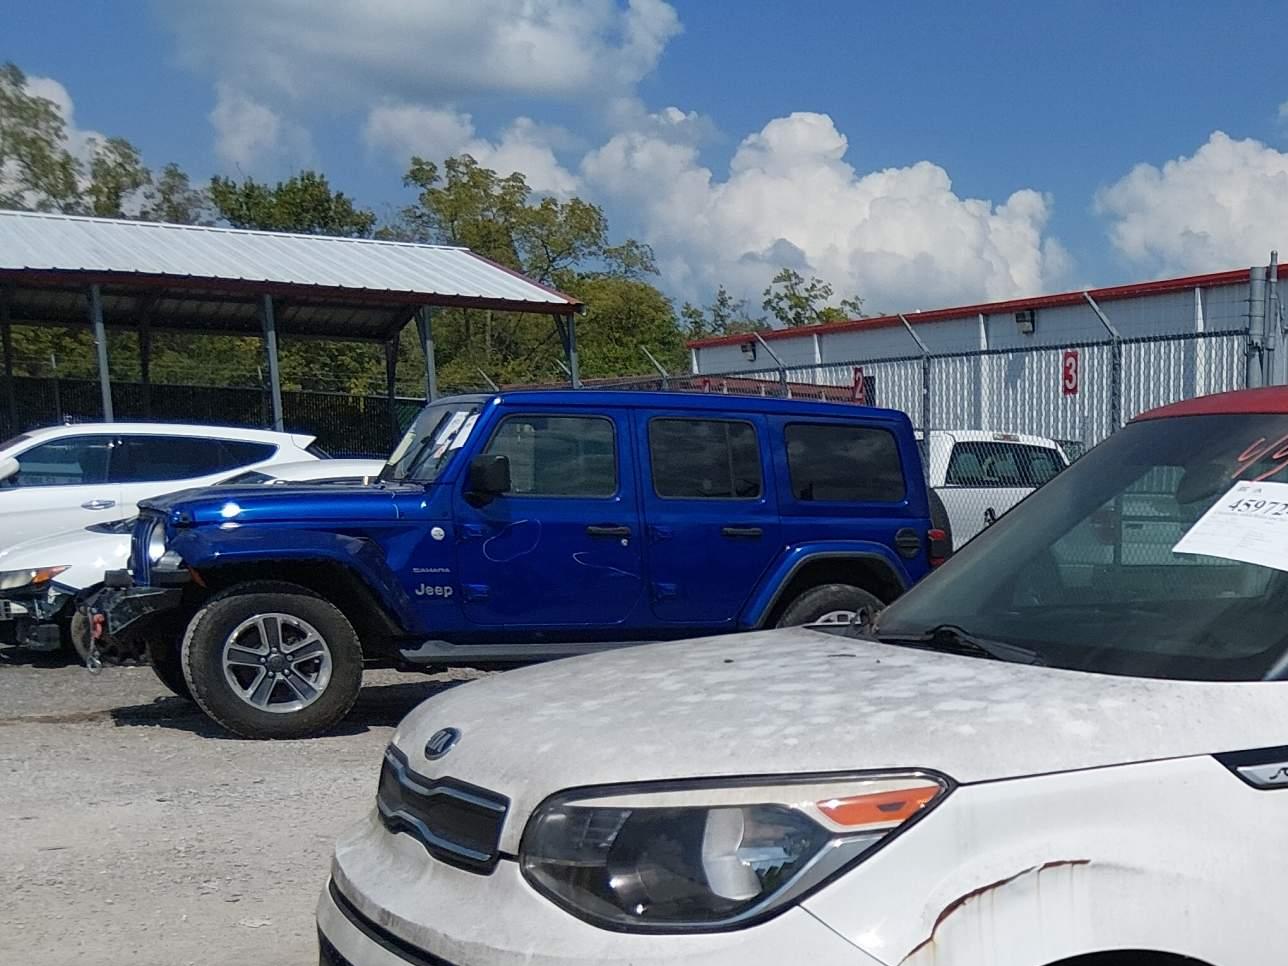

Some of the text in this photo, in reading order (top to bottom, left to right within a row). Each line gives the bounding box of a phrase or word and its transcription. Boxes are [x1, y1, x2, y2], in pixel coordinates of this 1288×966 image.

[855, 371, 863, 399] 2
[1065, 356, 1077, 390] 3
[415, 583, 454, 598] Jeep
